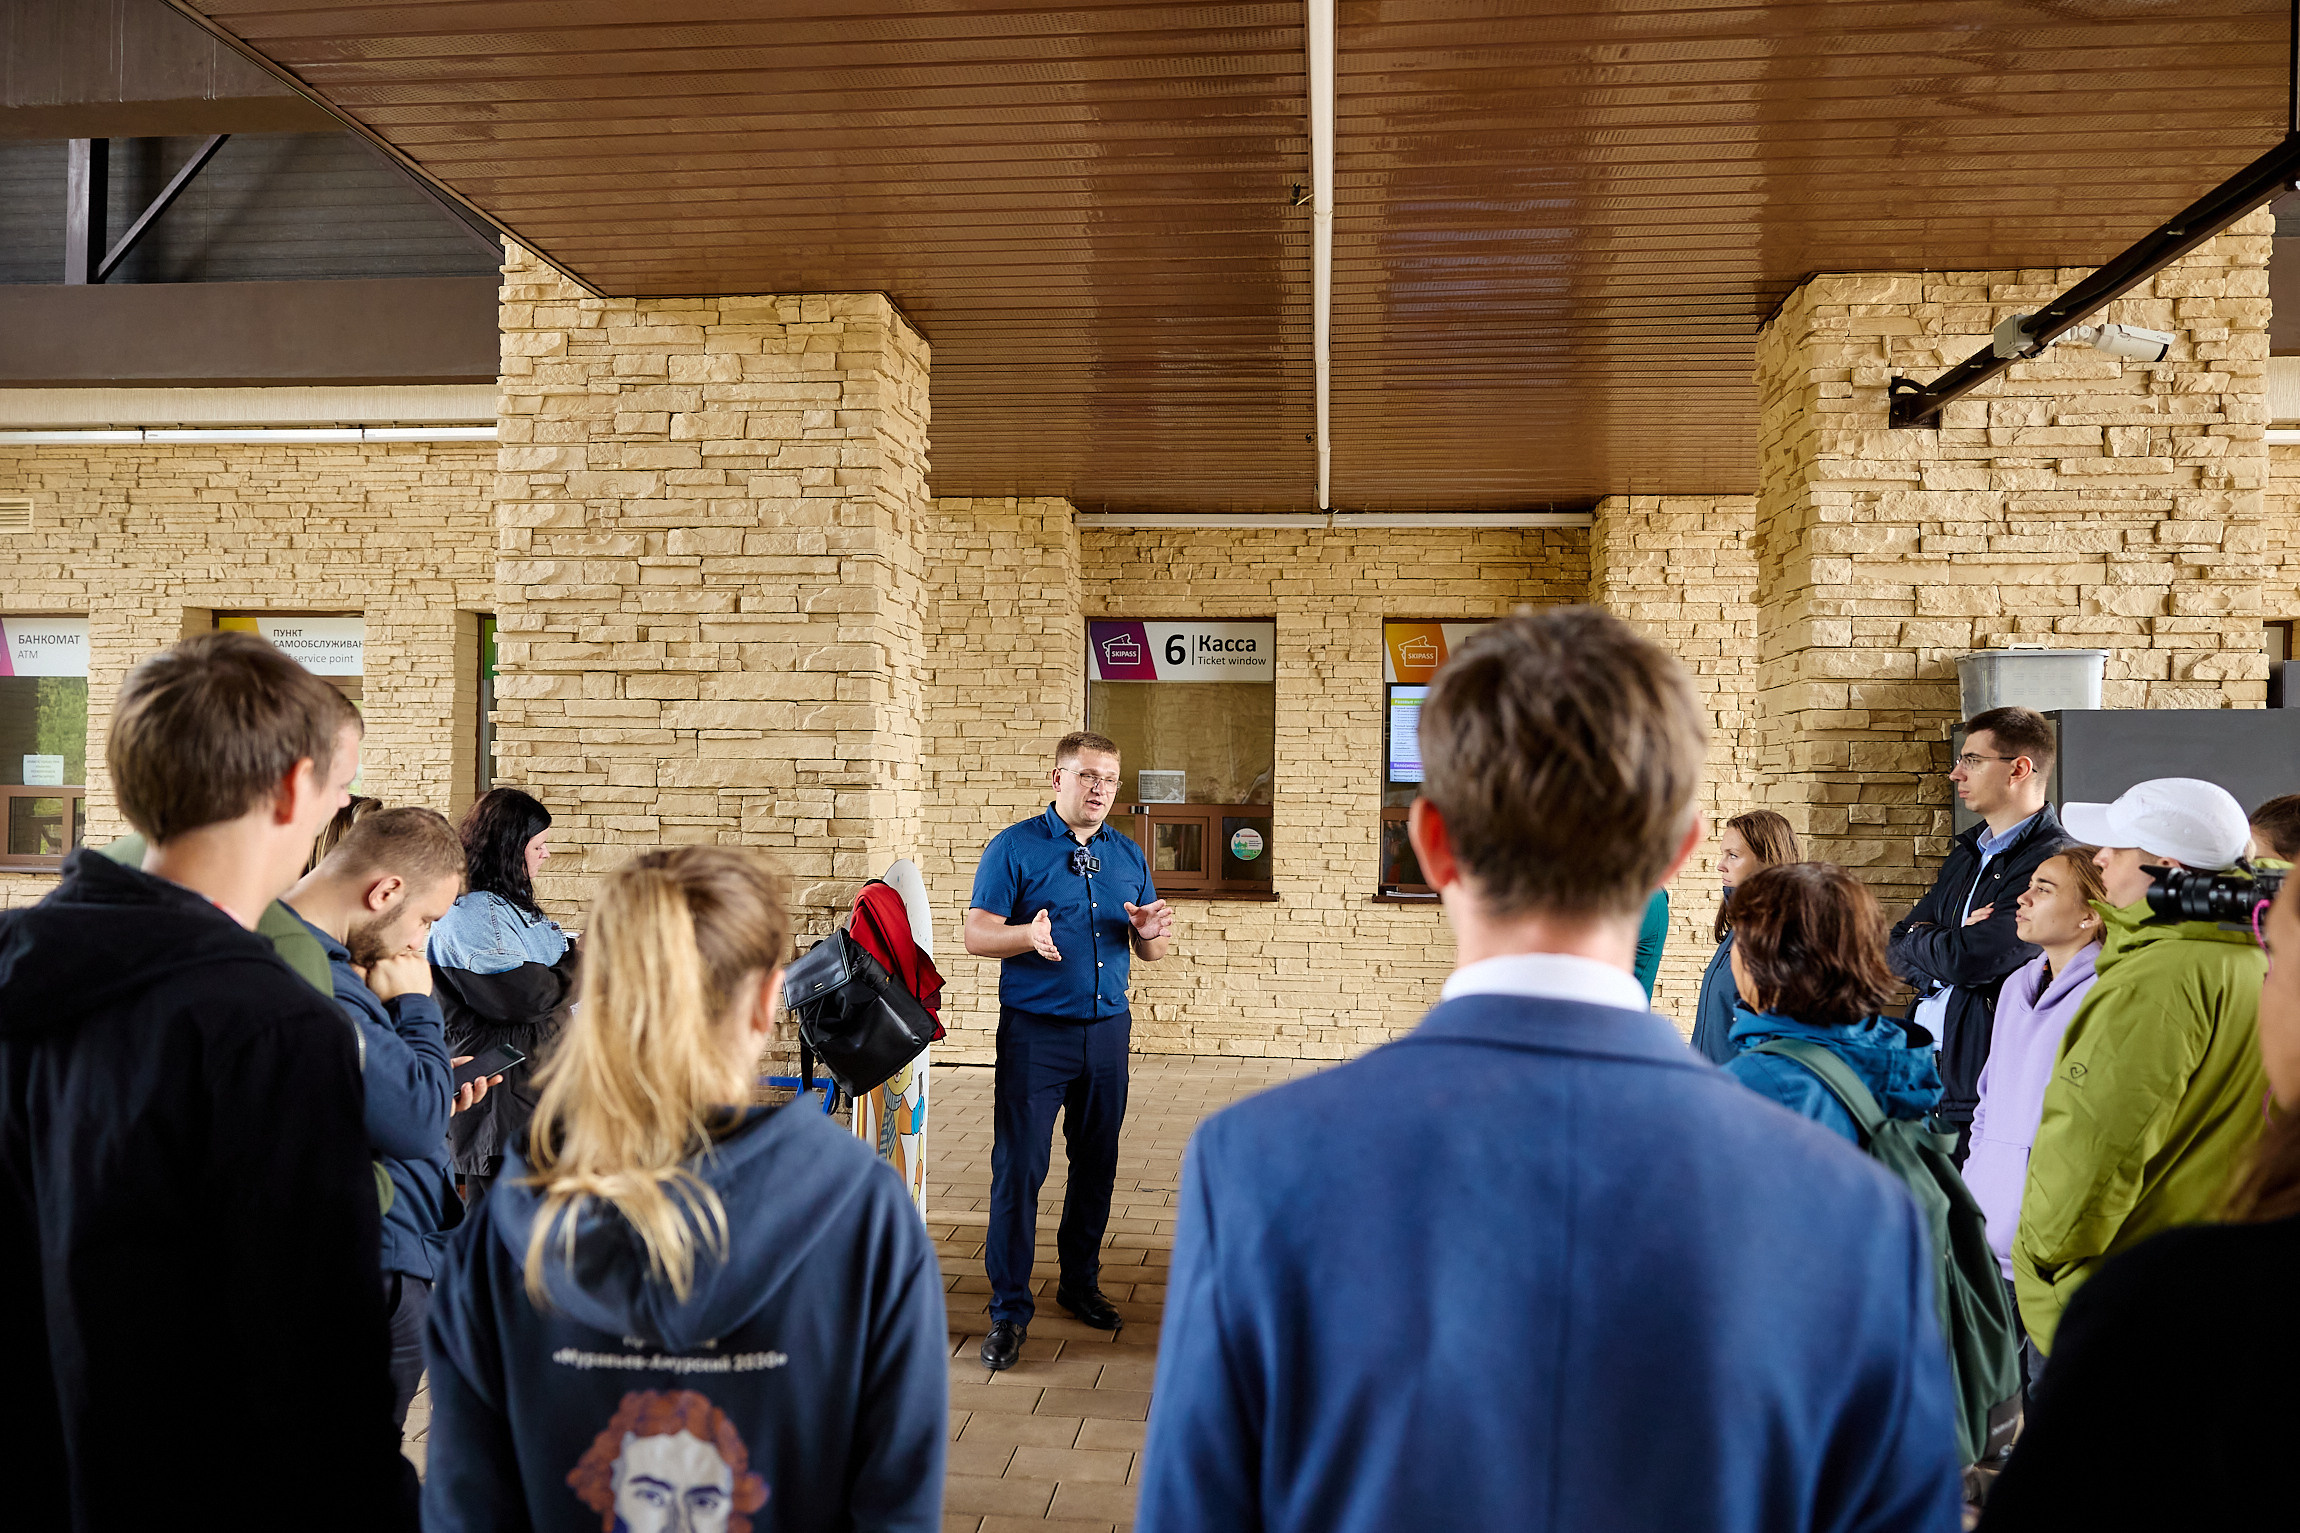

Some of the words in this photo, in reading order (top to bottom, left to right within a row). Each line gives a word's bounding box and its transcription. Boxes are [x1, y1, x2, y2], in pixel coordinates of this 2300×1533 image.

[273, 629, 303, 637] ПУНКТ
[18, 634, 80, 645] БАНКОМАТ
[1199, 635, 1257, 652] Касса
[18, 650, 38, 659] ATM
[1111, 650, 1137, 658] SKIPASS
[1165, 634, 1186, 666] 6
[293, 654, 327, 663] service
[329, 654, 354, 665] point
[1197, 656, 1226, 666] Ticket
[1228, 656, 1267, 666] window
[1408, 652, 1434, 660] SKIPASS
